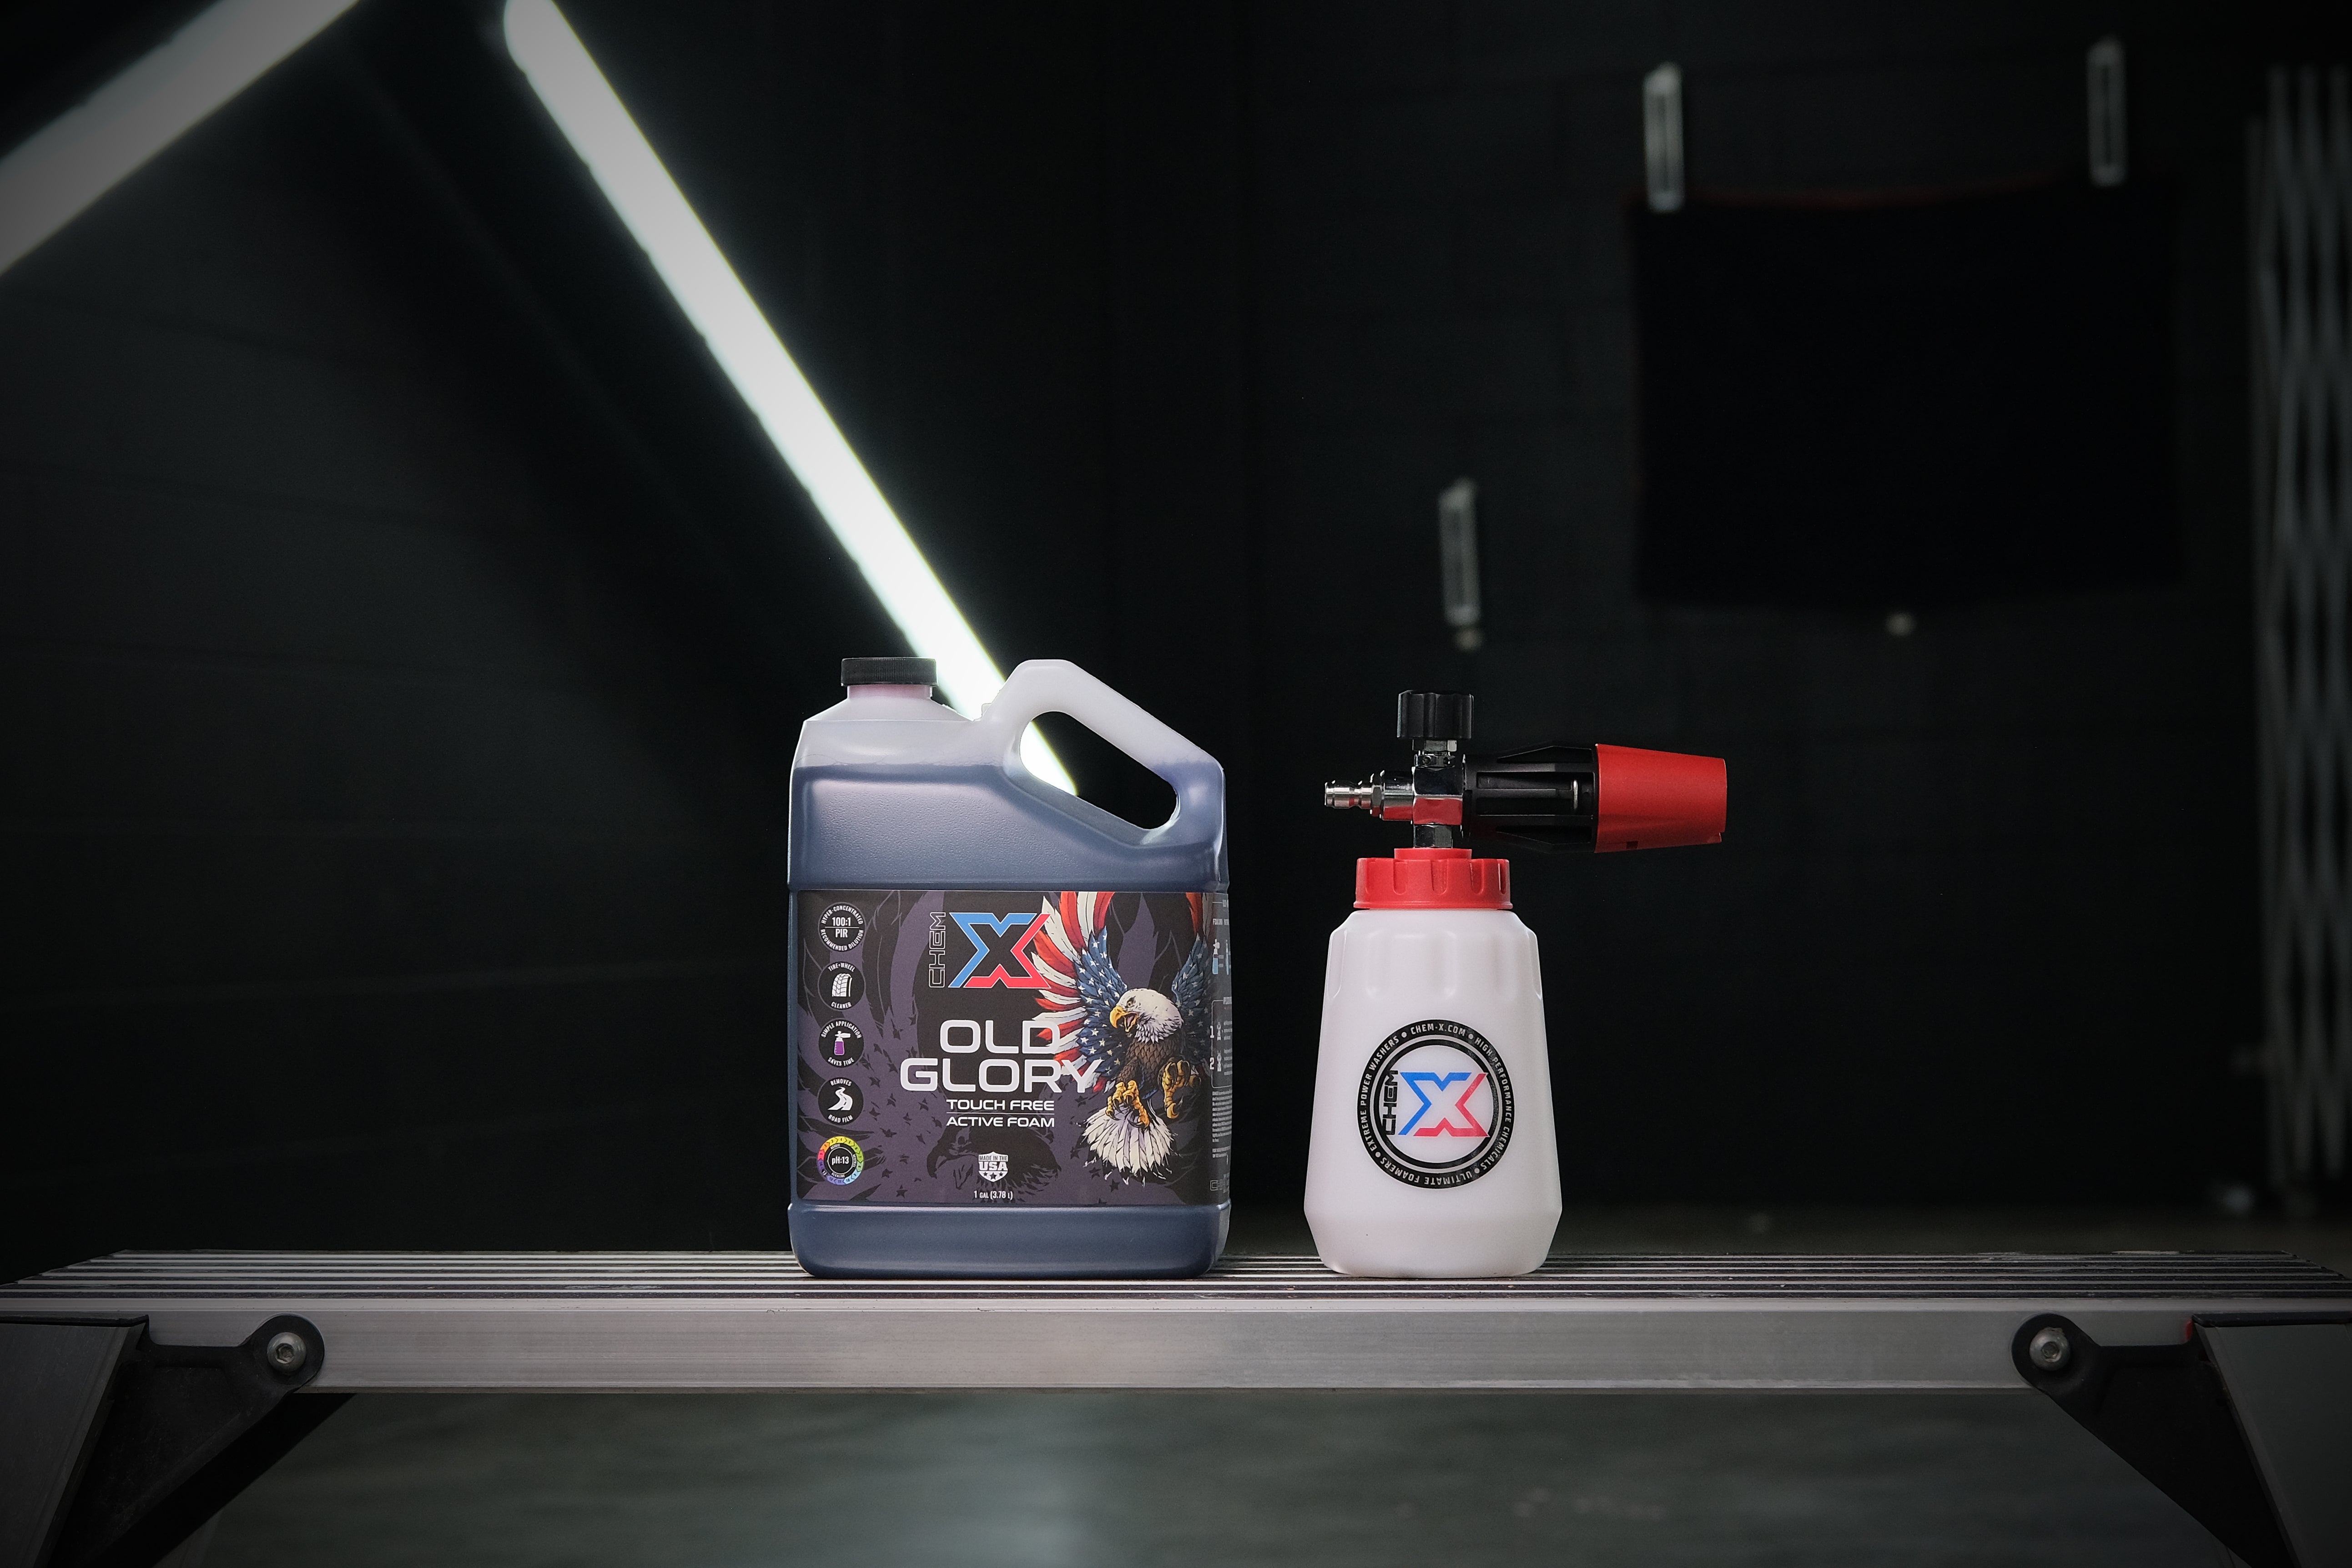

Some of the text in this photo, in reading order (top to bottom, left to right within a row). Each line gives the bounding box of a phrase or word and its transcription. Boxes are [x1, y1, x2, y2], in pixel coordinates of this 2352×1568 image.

[832, 917, 851, 926] 100:1
[835, 928, 848, 938] PIR
[821, 929, 864, 951] RECOMMENDED DILUTION
[929, 912, 946, 988] CHEM
[821, 1021, 862, 1039] SIMPLE APPLICATION
[1410, 1023, 1466, 1036] CHEM-X.COM
[940, 1020, 1060, 1054] OLD
[828, 1057, 854, 1066] SAVES TIME
[1209, 1057, 1214, 1070] 2
[900, 1058, 1104, 1093] GLORY
[1360, 1036, 1399, 1151] EXTREME POWER WASHERS
[946, 1099, 1054, 1111] TOUCH FREE
[1382, 1070, 1398, 1135] CHEM
[1475, 1037, 1511, 1170] HIGH PERFORMANCE CHEMICALS
[828, 1114, 853, 1123] ROAD FILM
[947, 1116, 1054, 1128] ACTIVE FOAM
[831, 1155, 849, 1166] pH:13
[978, 1161, 1008, 1171] USA
[1380, 1157, 1472, 1185] ULTIMATE FOAMERS
[974, 1190, 977, 1199] 1
[990, 1190, 1006, 1200] (3.78
